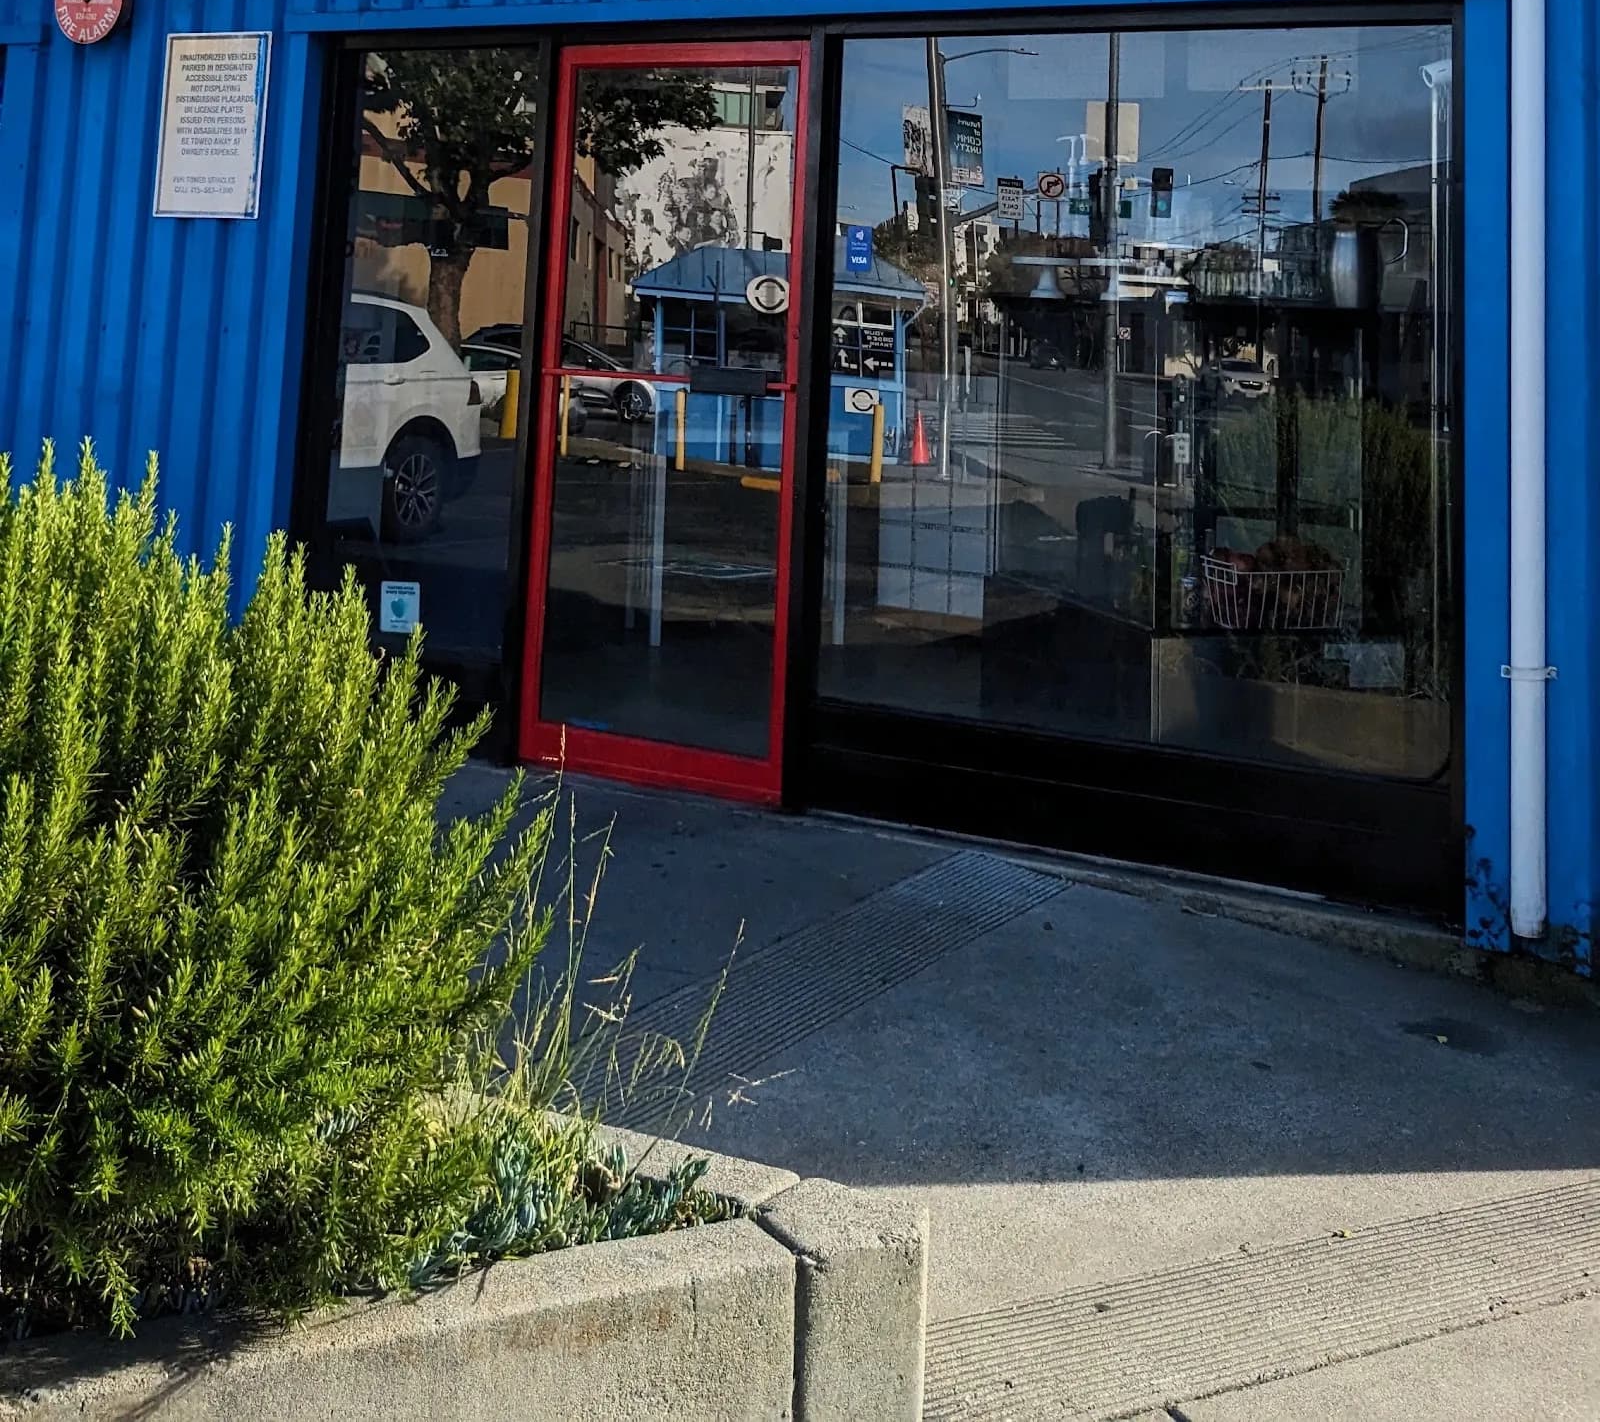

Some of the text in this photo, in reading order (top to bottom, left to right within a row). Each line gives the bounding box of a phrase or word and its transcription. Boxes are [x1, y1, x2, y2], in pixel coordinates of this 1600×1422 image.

[58, 5, 116, 41] FIRE ALARM
[227, 53, 256, 61] VEHICLES
[215, 63, 253, 71] DESIGNATED
[185, 73, 248, 82] ACCESSIBLE SPACES
[191, 84, 240, 92] NOT DISPLAYING
[221, 95, 254, 103] PLACARDS
[180, 116, 202, 124] ISSUED
[851, 256, 867, 264] VISA
